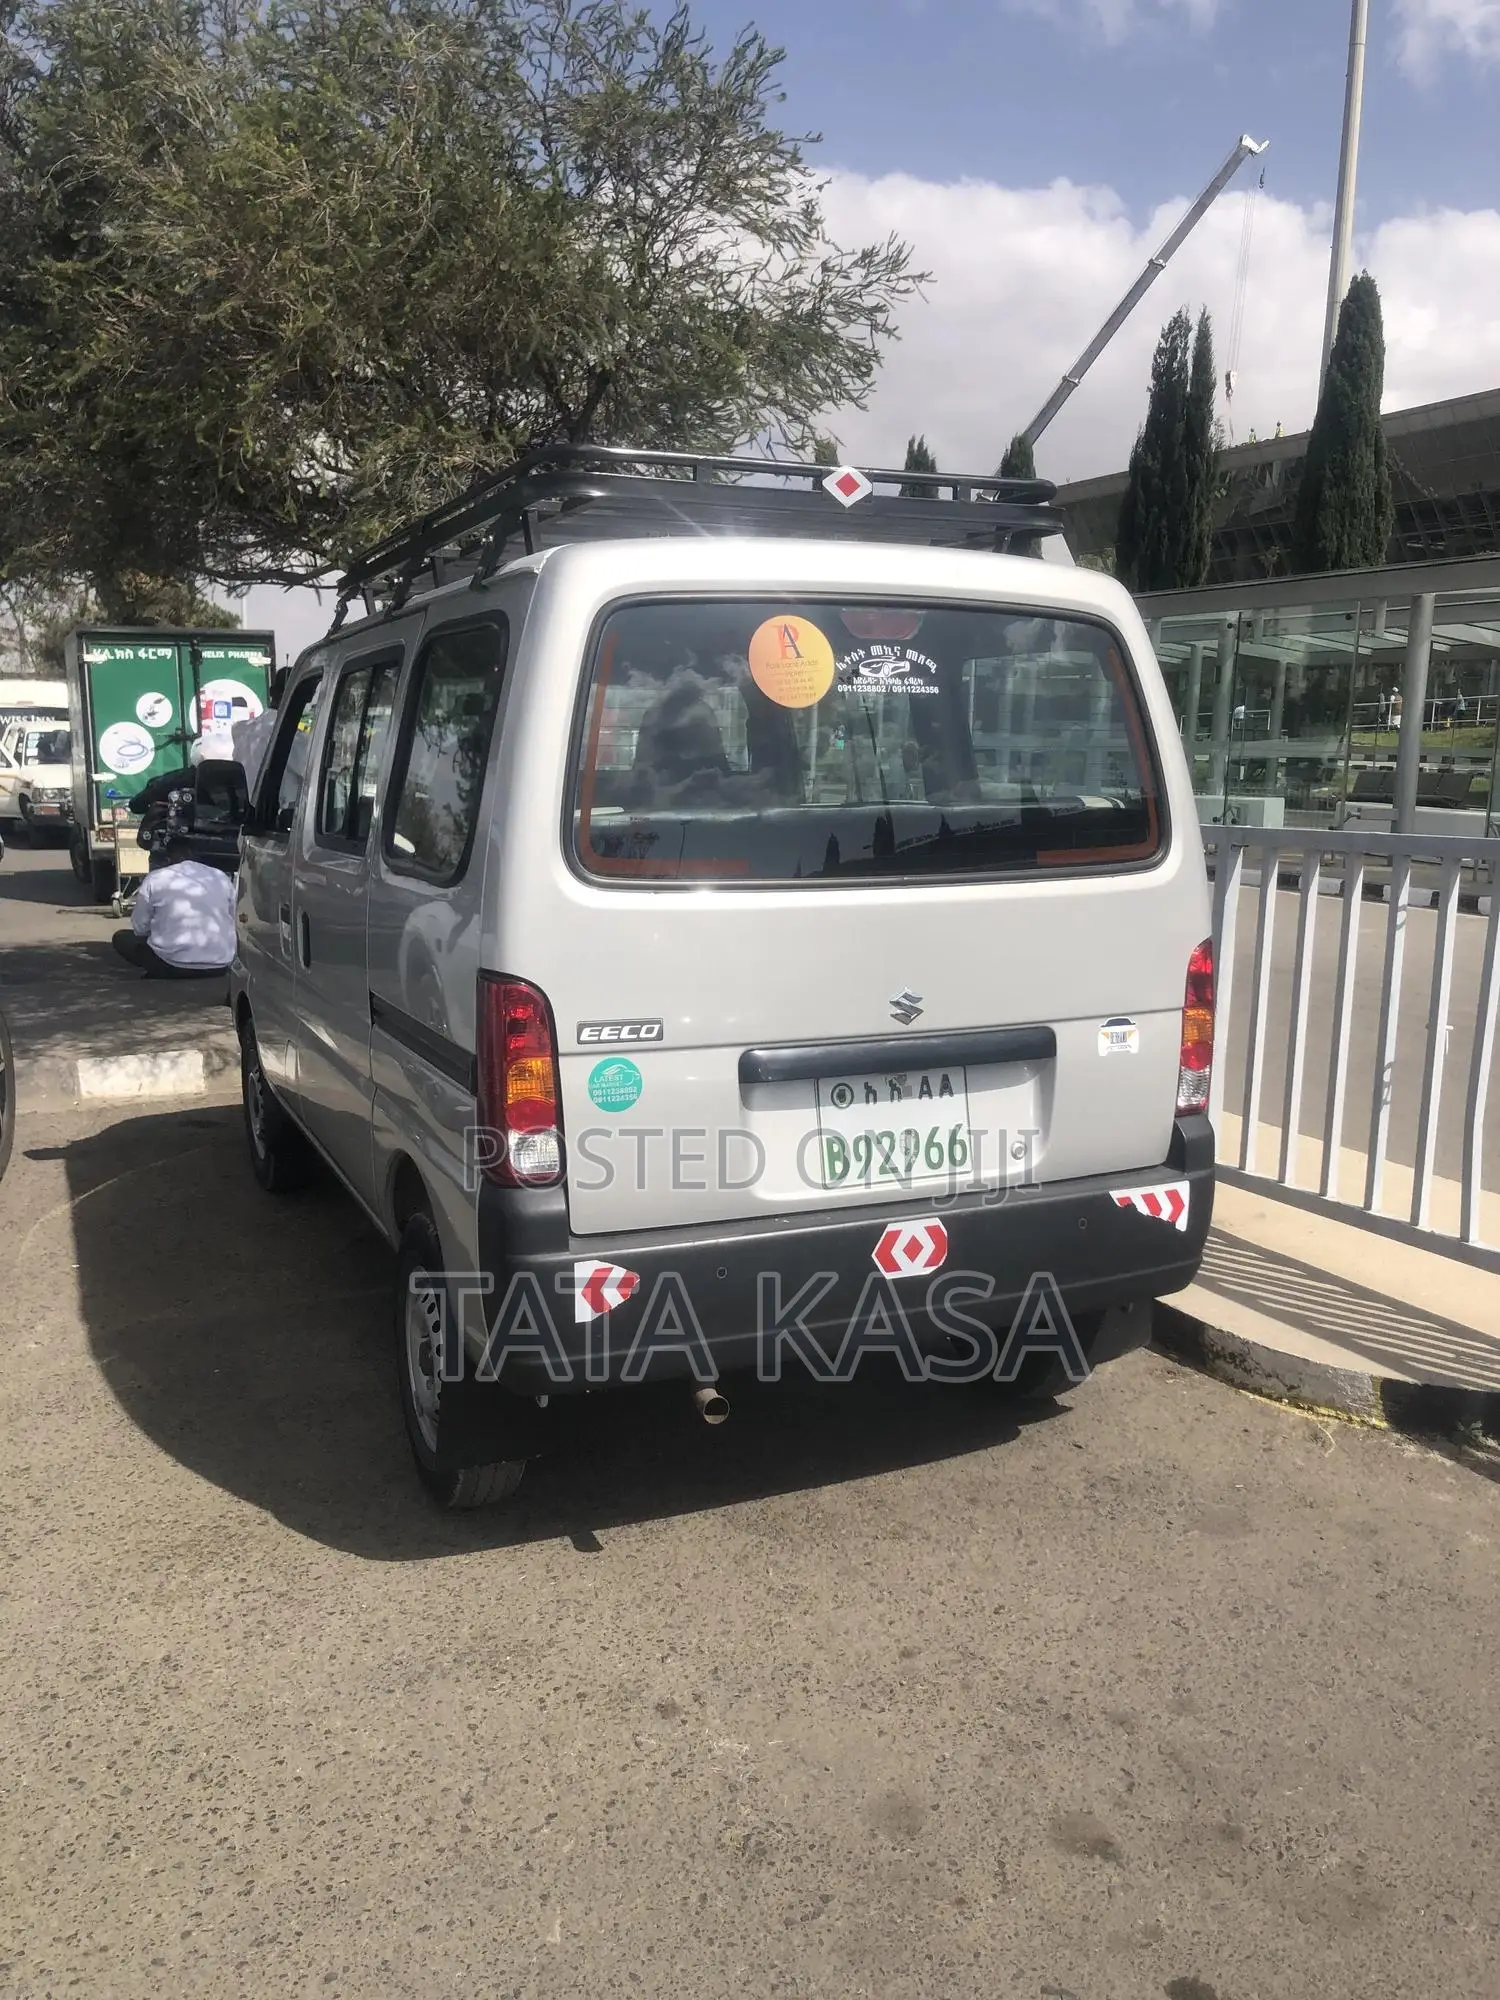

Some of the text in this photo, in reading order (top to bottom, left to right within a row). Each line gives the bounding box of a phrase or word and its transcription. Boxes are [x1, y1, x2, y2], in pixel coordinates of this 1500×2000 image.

[138, 647, 172, 660] ፋርማ
[201, 650, 263, 659] HELIX PHARMA
[870, 644, 901, 657] መኪና
[837, 684, 886, 693] 0911238802
[579, 1024, 661, 1041] EECO
[594, 1073, 623, 1083] LATEST
[918, 1073, 954, 1099] AA
[826, 1123, 968, 1180] B92966
